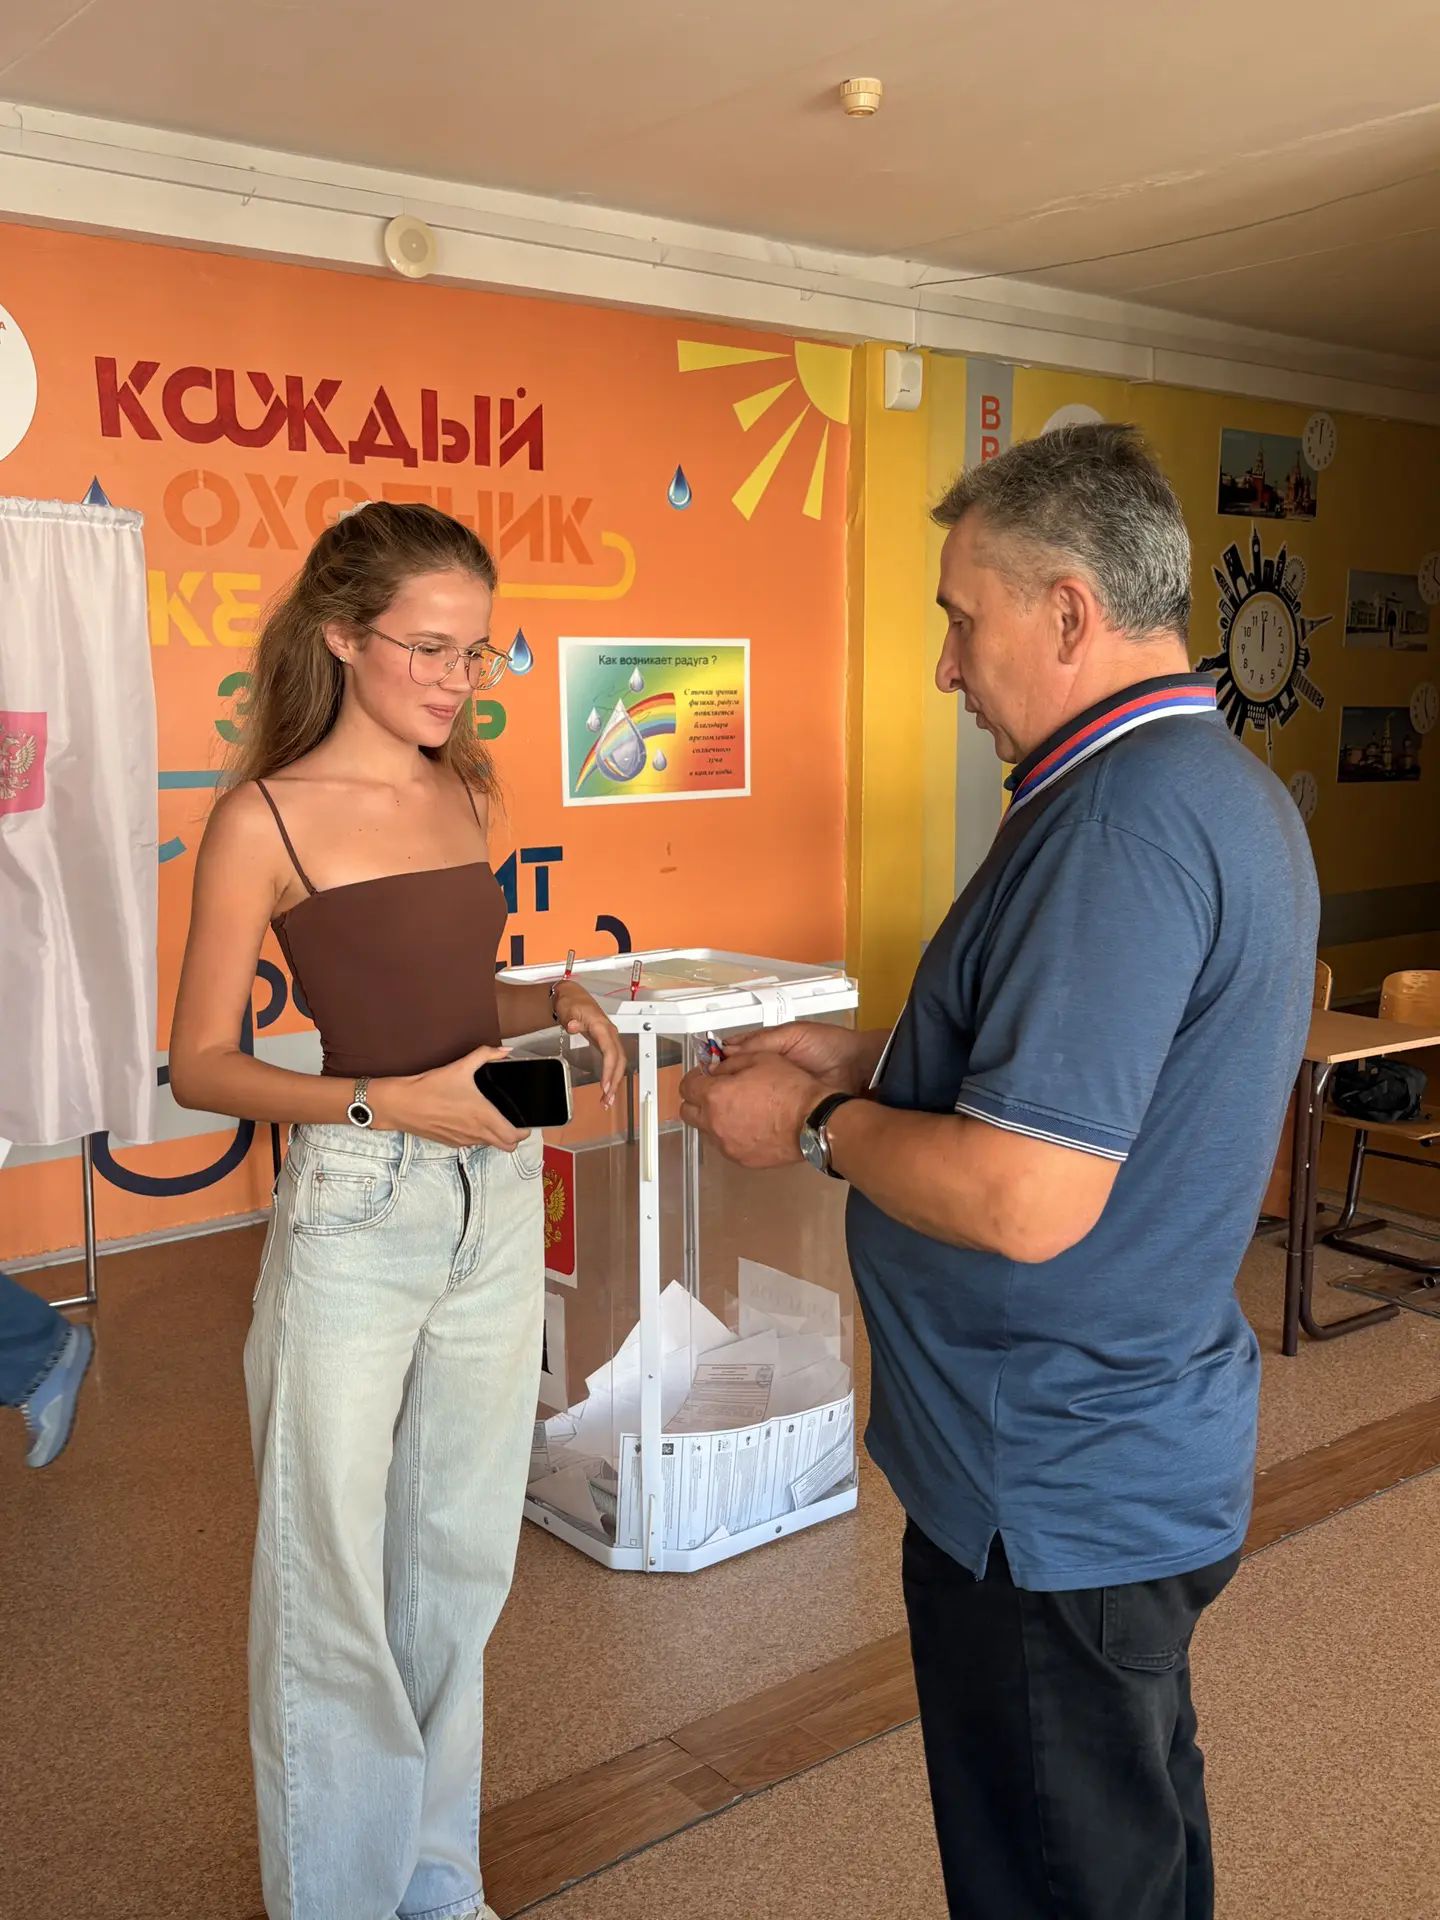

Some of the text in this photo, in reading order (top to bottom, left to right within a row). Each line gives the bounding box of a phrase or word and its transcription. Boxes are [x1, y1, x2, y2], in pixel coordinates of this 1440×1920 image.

[1252, 616, 1258, 627] 11
[1243, 626, 1251, 637] 10
[1277, 626, 1283, 637] 2
[1241, 643, 1246, 654] 9
[1280, 643, 1285, 654] 3
[598, 655, 718, 667] Как возникает радуга ?
[1243, 658, 1248, 669] 8
[1249, 669, 1254, 680] 7
[1259, 674, 1264, 685] 6
[1270, 669, 1275, 680] 5
